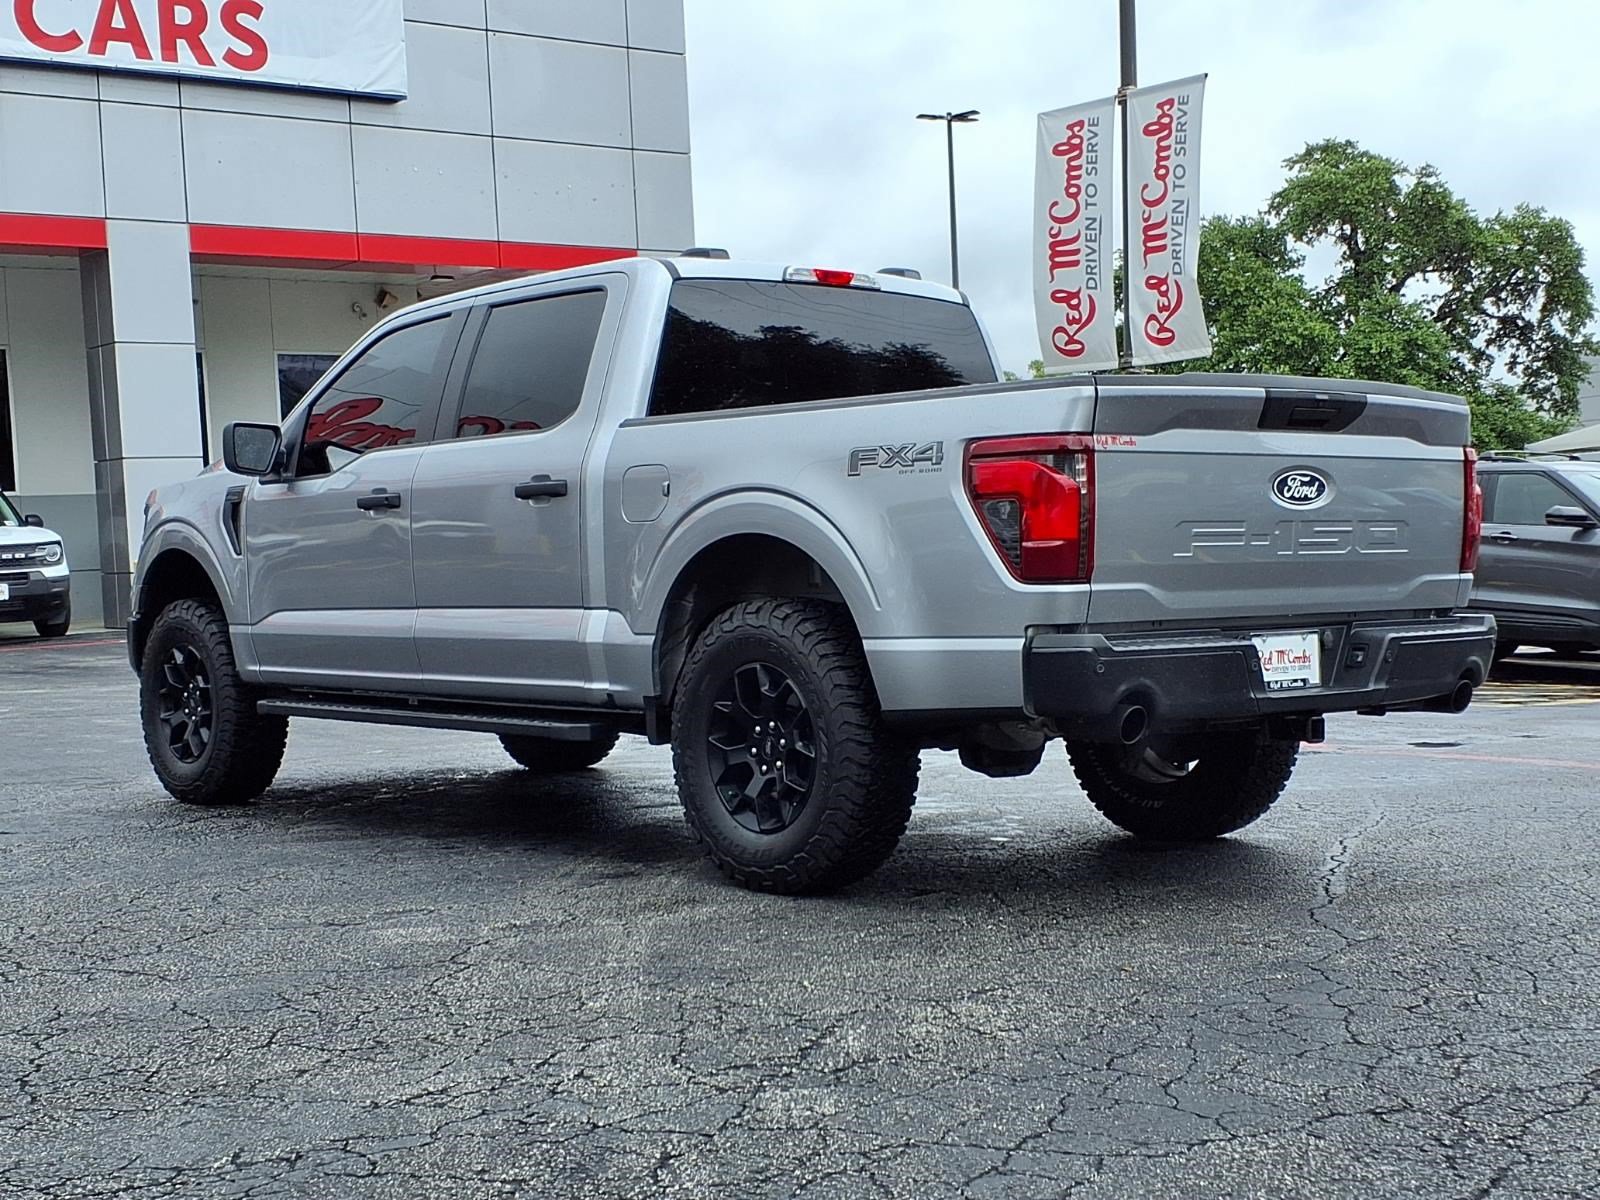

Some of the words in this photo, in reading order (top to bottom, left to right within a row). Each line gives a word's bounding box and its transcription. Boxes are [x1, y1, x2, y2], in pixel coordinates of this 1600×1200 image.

[14, 0, 269, 71] CARS
[1085, 116, 1100, 176] SERVE
[1174, 95, 1190, 157] SERVE
[1049, 118, 1086, 283] McCombs
[1085, 183, 1098, 207] TO
[1141, 97, 1176, 270] McCombs
[1172, 164, 1186, 192] TO
[1085, 217, 1098, 290] DRIVEN
[1172, 200, 1185, 275] DRIVEN
[1050, 286, 1096, 358] Red
[1144, 272, 1183, 346] Red
[848, 441, 944, 477] FX4
[1283, 475, 1319, 500] Ford
[1173, 520, 1409, 557] F-150
